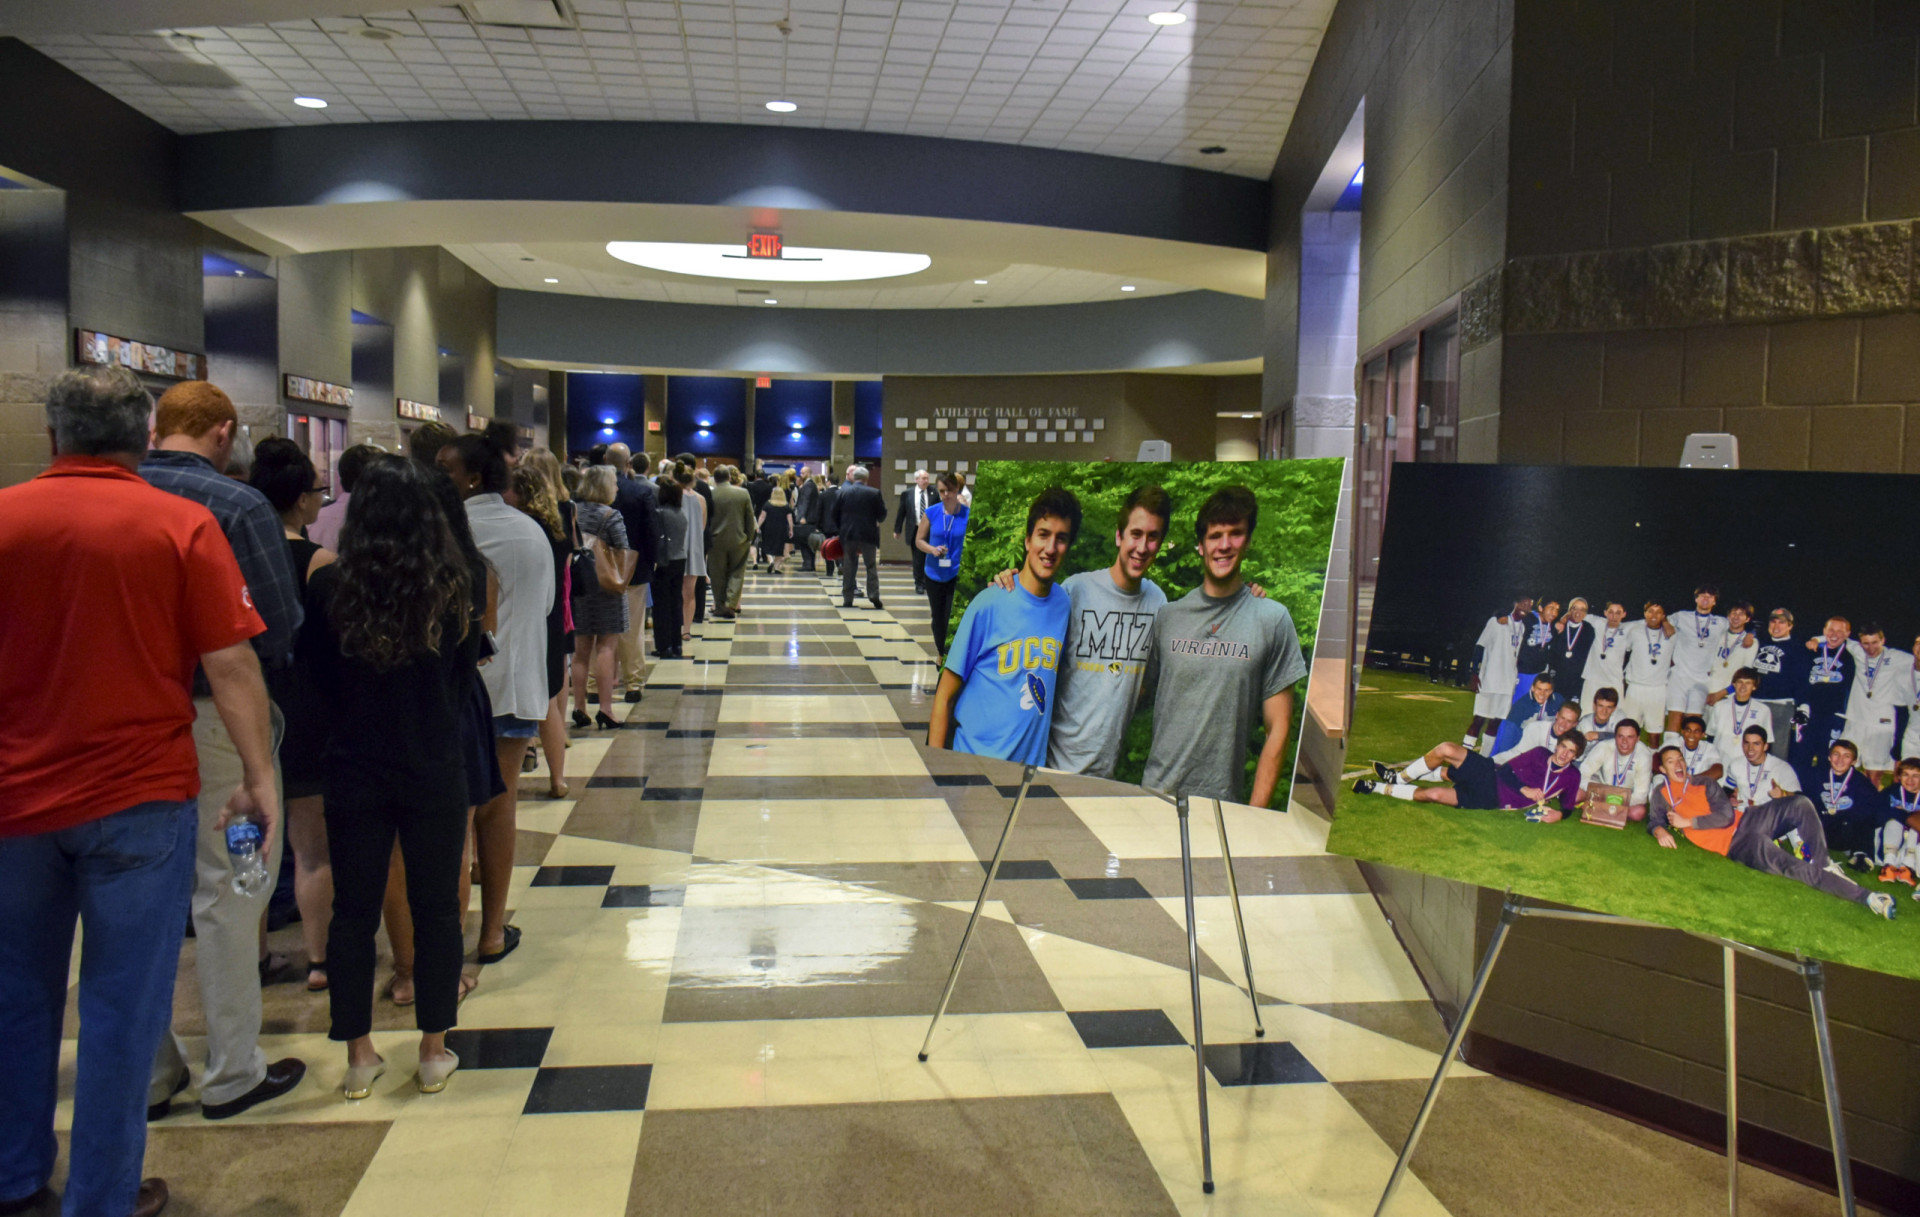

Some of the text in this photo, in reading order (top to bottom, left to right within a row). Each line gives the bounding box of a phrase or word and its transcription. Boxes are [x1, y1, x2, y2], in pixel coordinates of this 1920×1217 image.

[752, 234, 779, 257] EXIT
[933, 407, 1079, 417] ATHLETIC HALL OF FAME
[1171, 639, 1250, 660] VIRGINIA
[1648, 643, 1662, 655] 12
